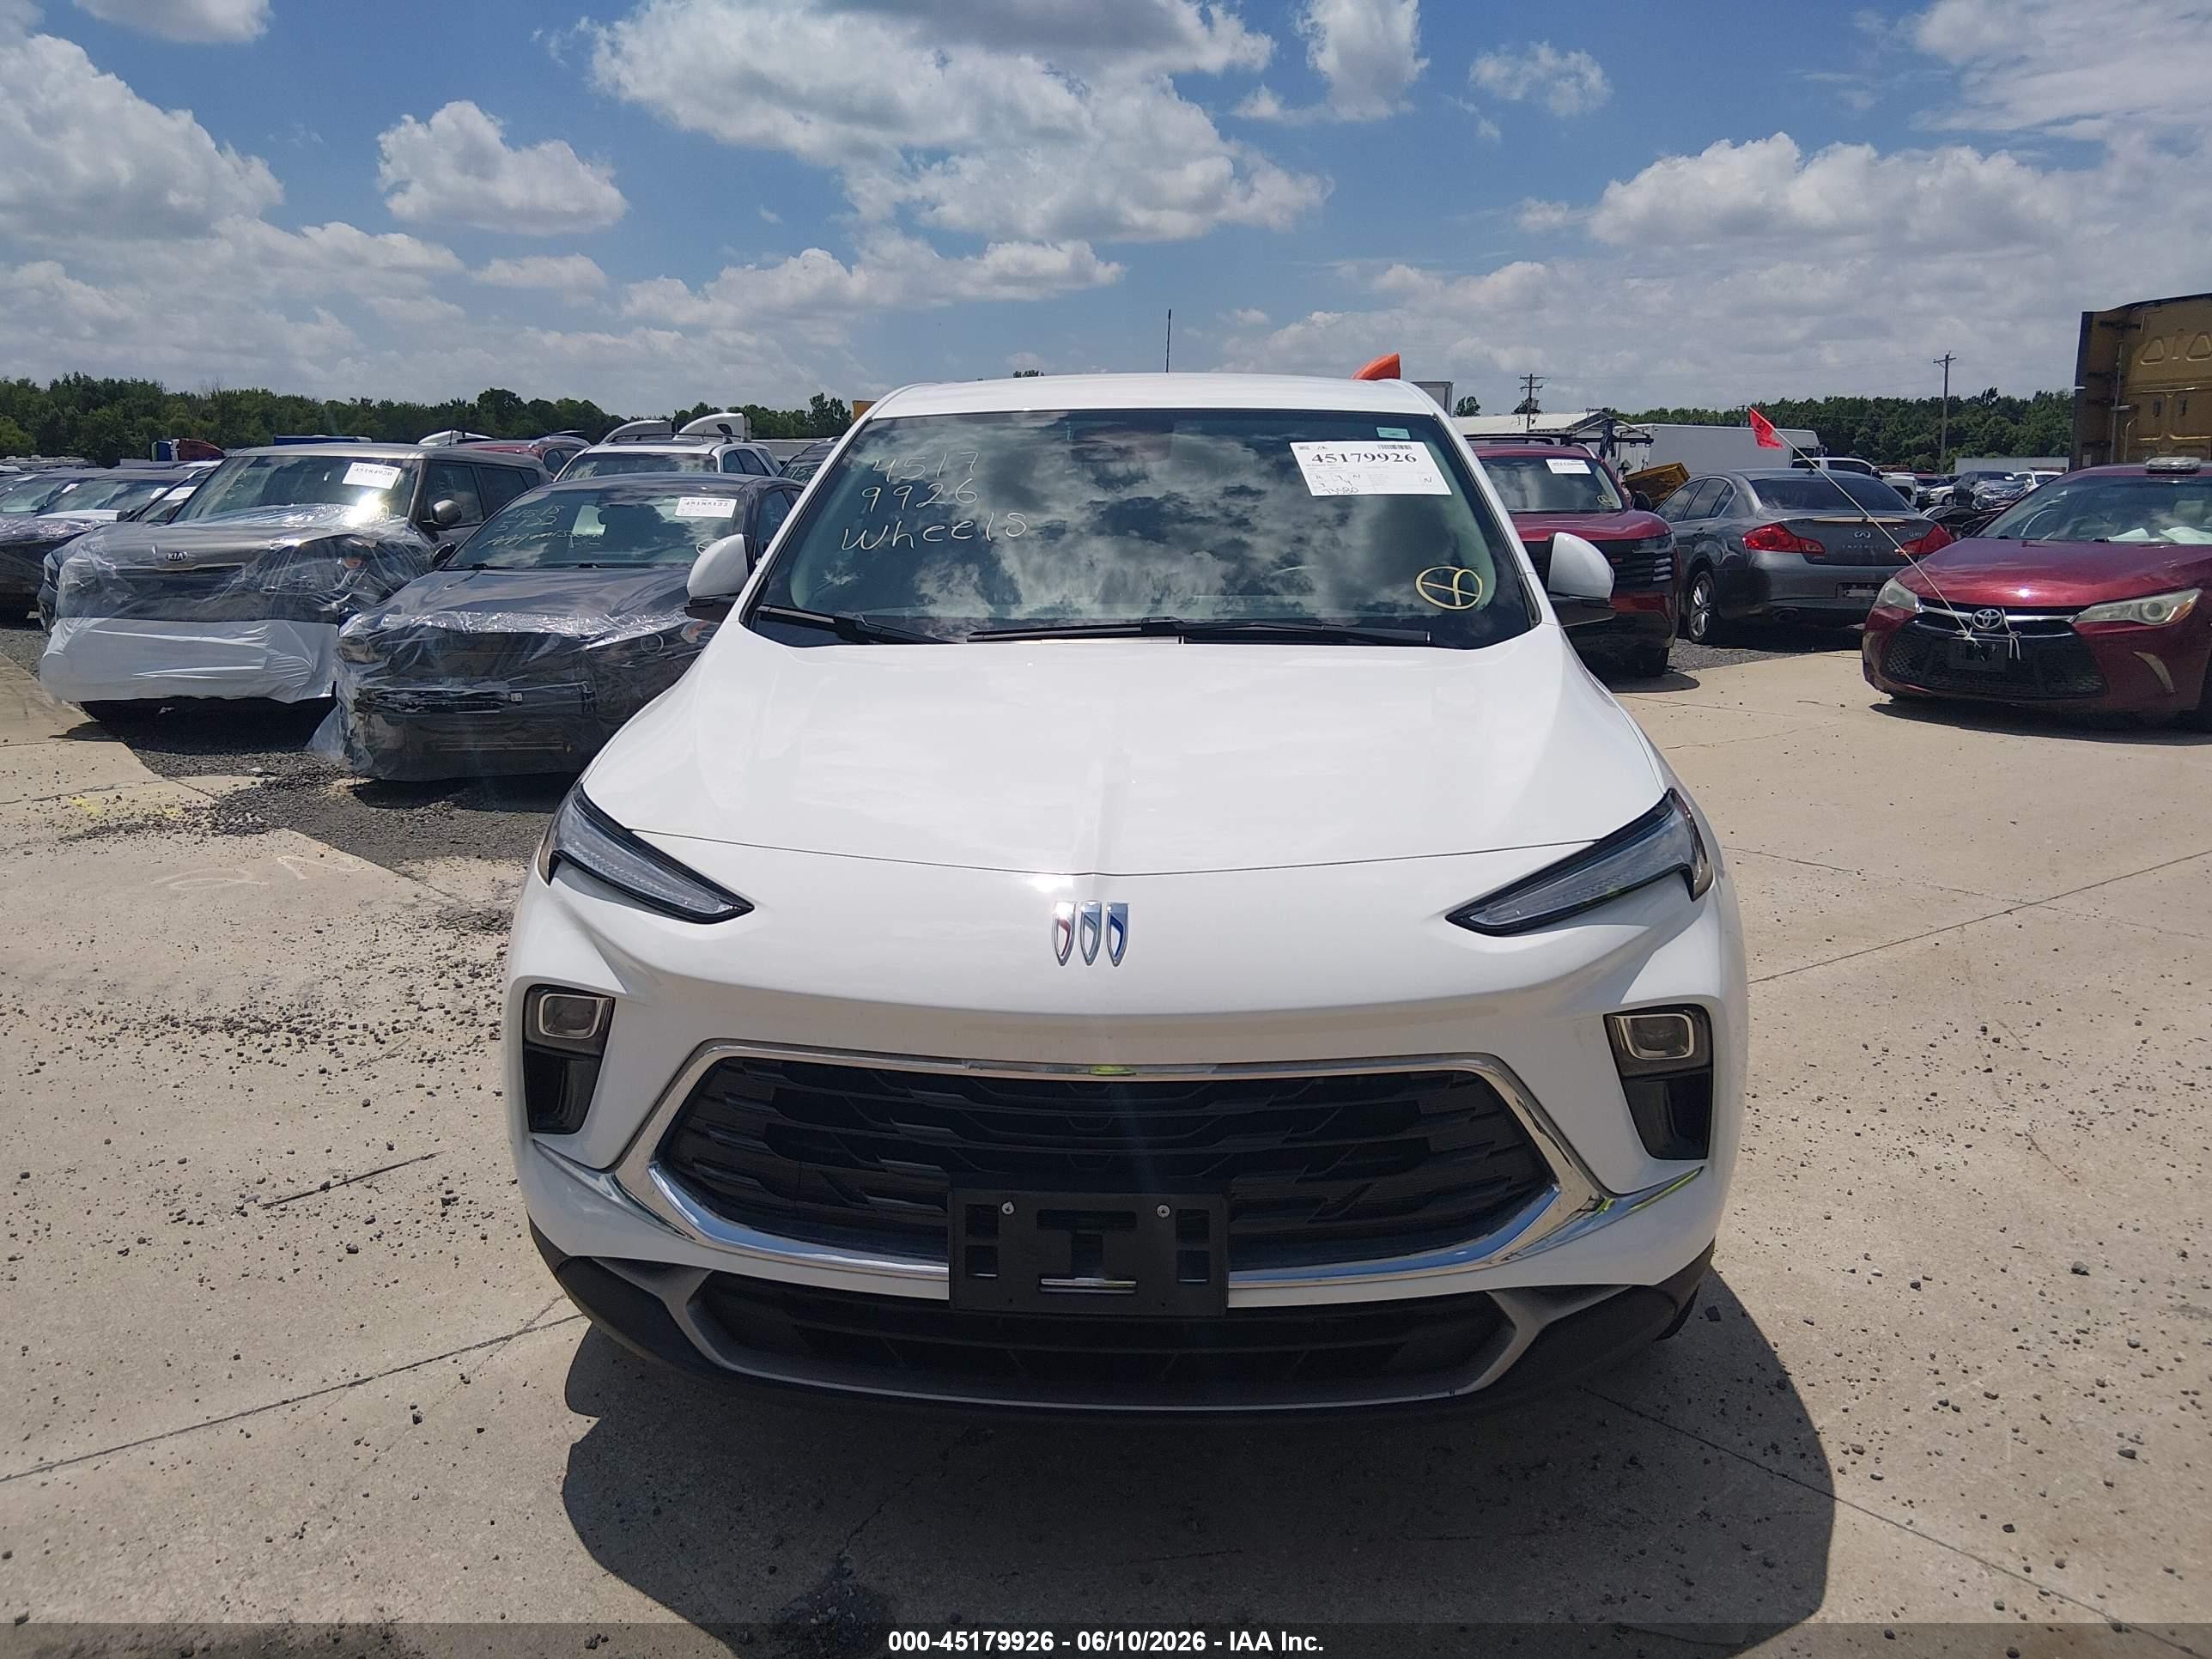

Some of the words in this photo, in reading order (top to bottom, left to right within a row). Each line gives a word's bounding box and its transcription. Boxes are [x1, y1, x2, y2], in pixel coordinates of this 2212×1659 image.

[872, 452, 979, 483] 4517
[1311, 453, 1418, 465] 45179926
[861, 478, 978, 514] 9926
